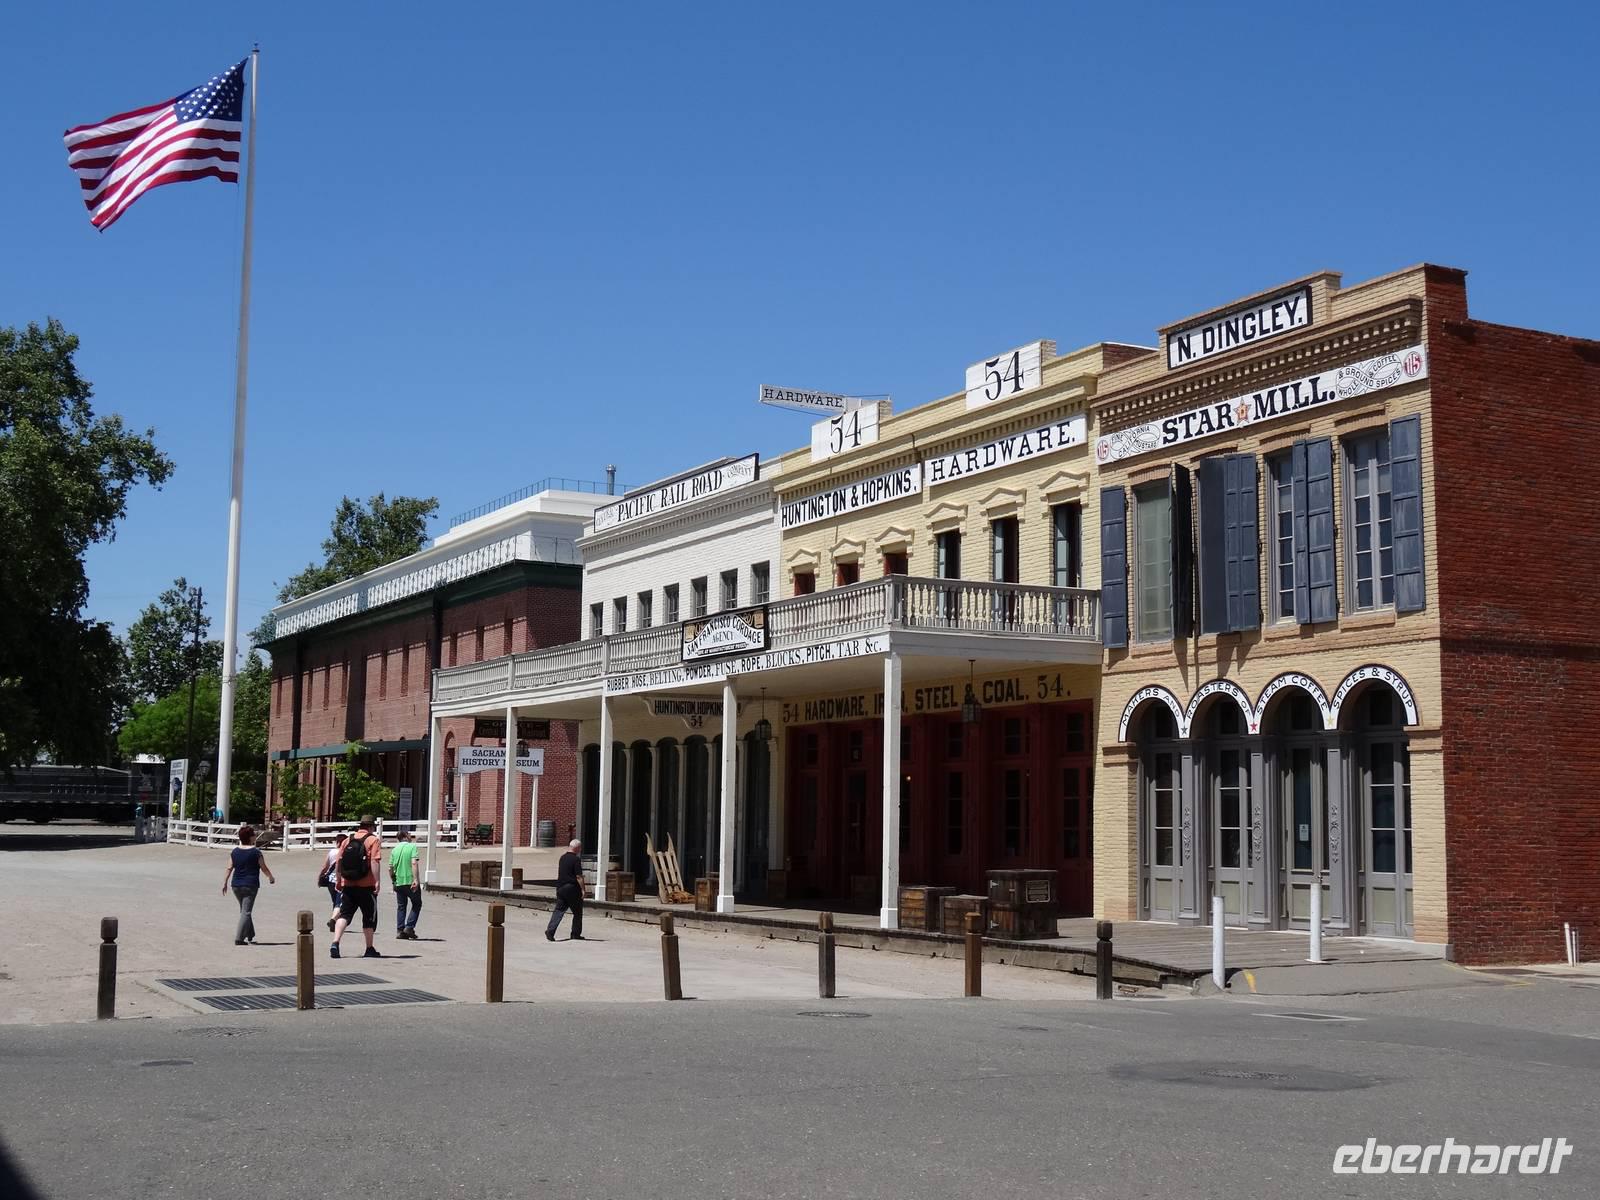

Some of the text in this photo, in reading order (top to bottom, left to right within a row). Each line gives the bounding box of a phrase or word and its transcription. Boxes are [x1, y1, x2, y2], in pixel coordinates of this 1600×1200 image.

[1177, 296, 1303, 362] N. DINGLEY.
[984, 351, 1025, 401] 54
[1345, 367, 1374, 387] GROUND
[1376, 368, 1401, 388] SPICES
[1373, 355, 1397, 372] COFFEE
[1338, 380, 1359, 397] WHOLE
[1162, 376, 1336, 445] STAR MILL.
[830, 410, 862, 454] 54
[931, 421, 1075, 482] HARDWARE.
[1119, 425, 1150, 458] CALIFORNIA
[617, 493, 656, 523] PACIFIC
[661, 482, 688, 508] RAIL
[691, 469, 723, 498] ROAD
[781, 469, 917, 528] HUNTINGTON & HOPKINS.
[687, 615, 762, 656] SAN FRANCISCO CORDAGE
[606, 677, 629, 691] RUBBER
[837, 639, 860, 658] TAR
[783, 703, 800, 723] 54
[915, 684, 958, 711] STEEL
[982, 678, 1029, 704] COAL.
[1122, 688, 1180, 726] MAKERS AND
[1187, 682, 1239, 719] ROASTERS
[1256, 675, 1328, 715] STEAM COFFEE
[1333, 667, 1413, 709] SPICES & SYRUP
[690, 715, 703, 727] 54
[462, 758, 540, 767] HISTORY SEUM
[472, 749, 506, 758] SACRAM
